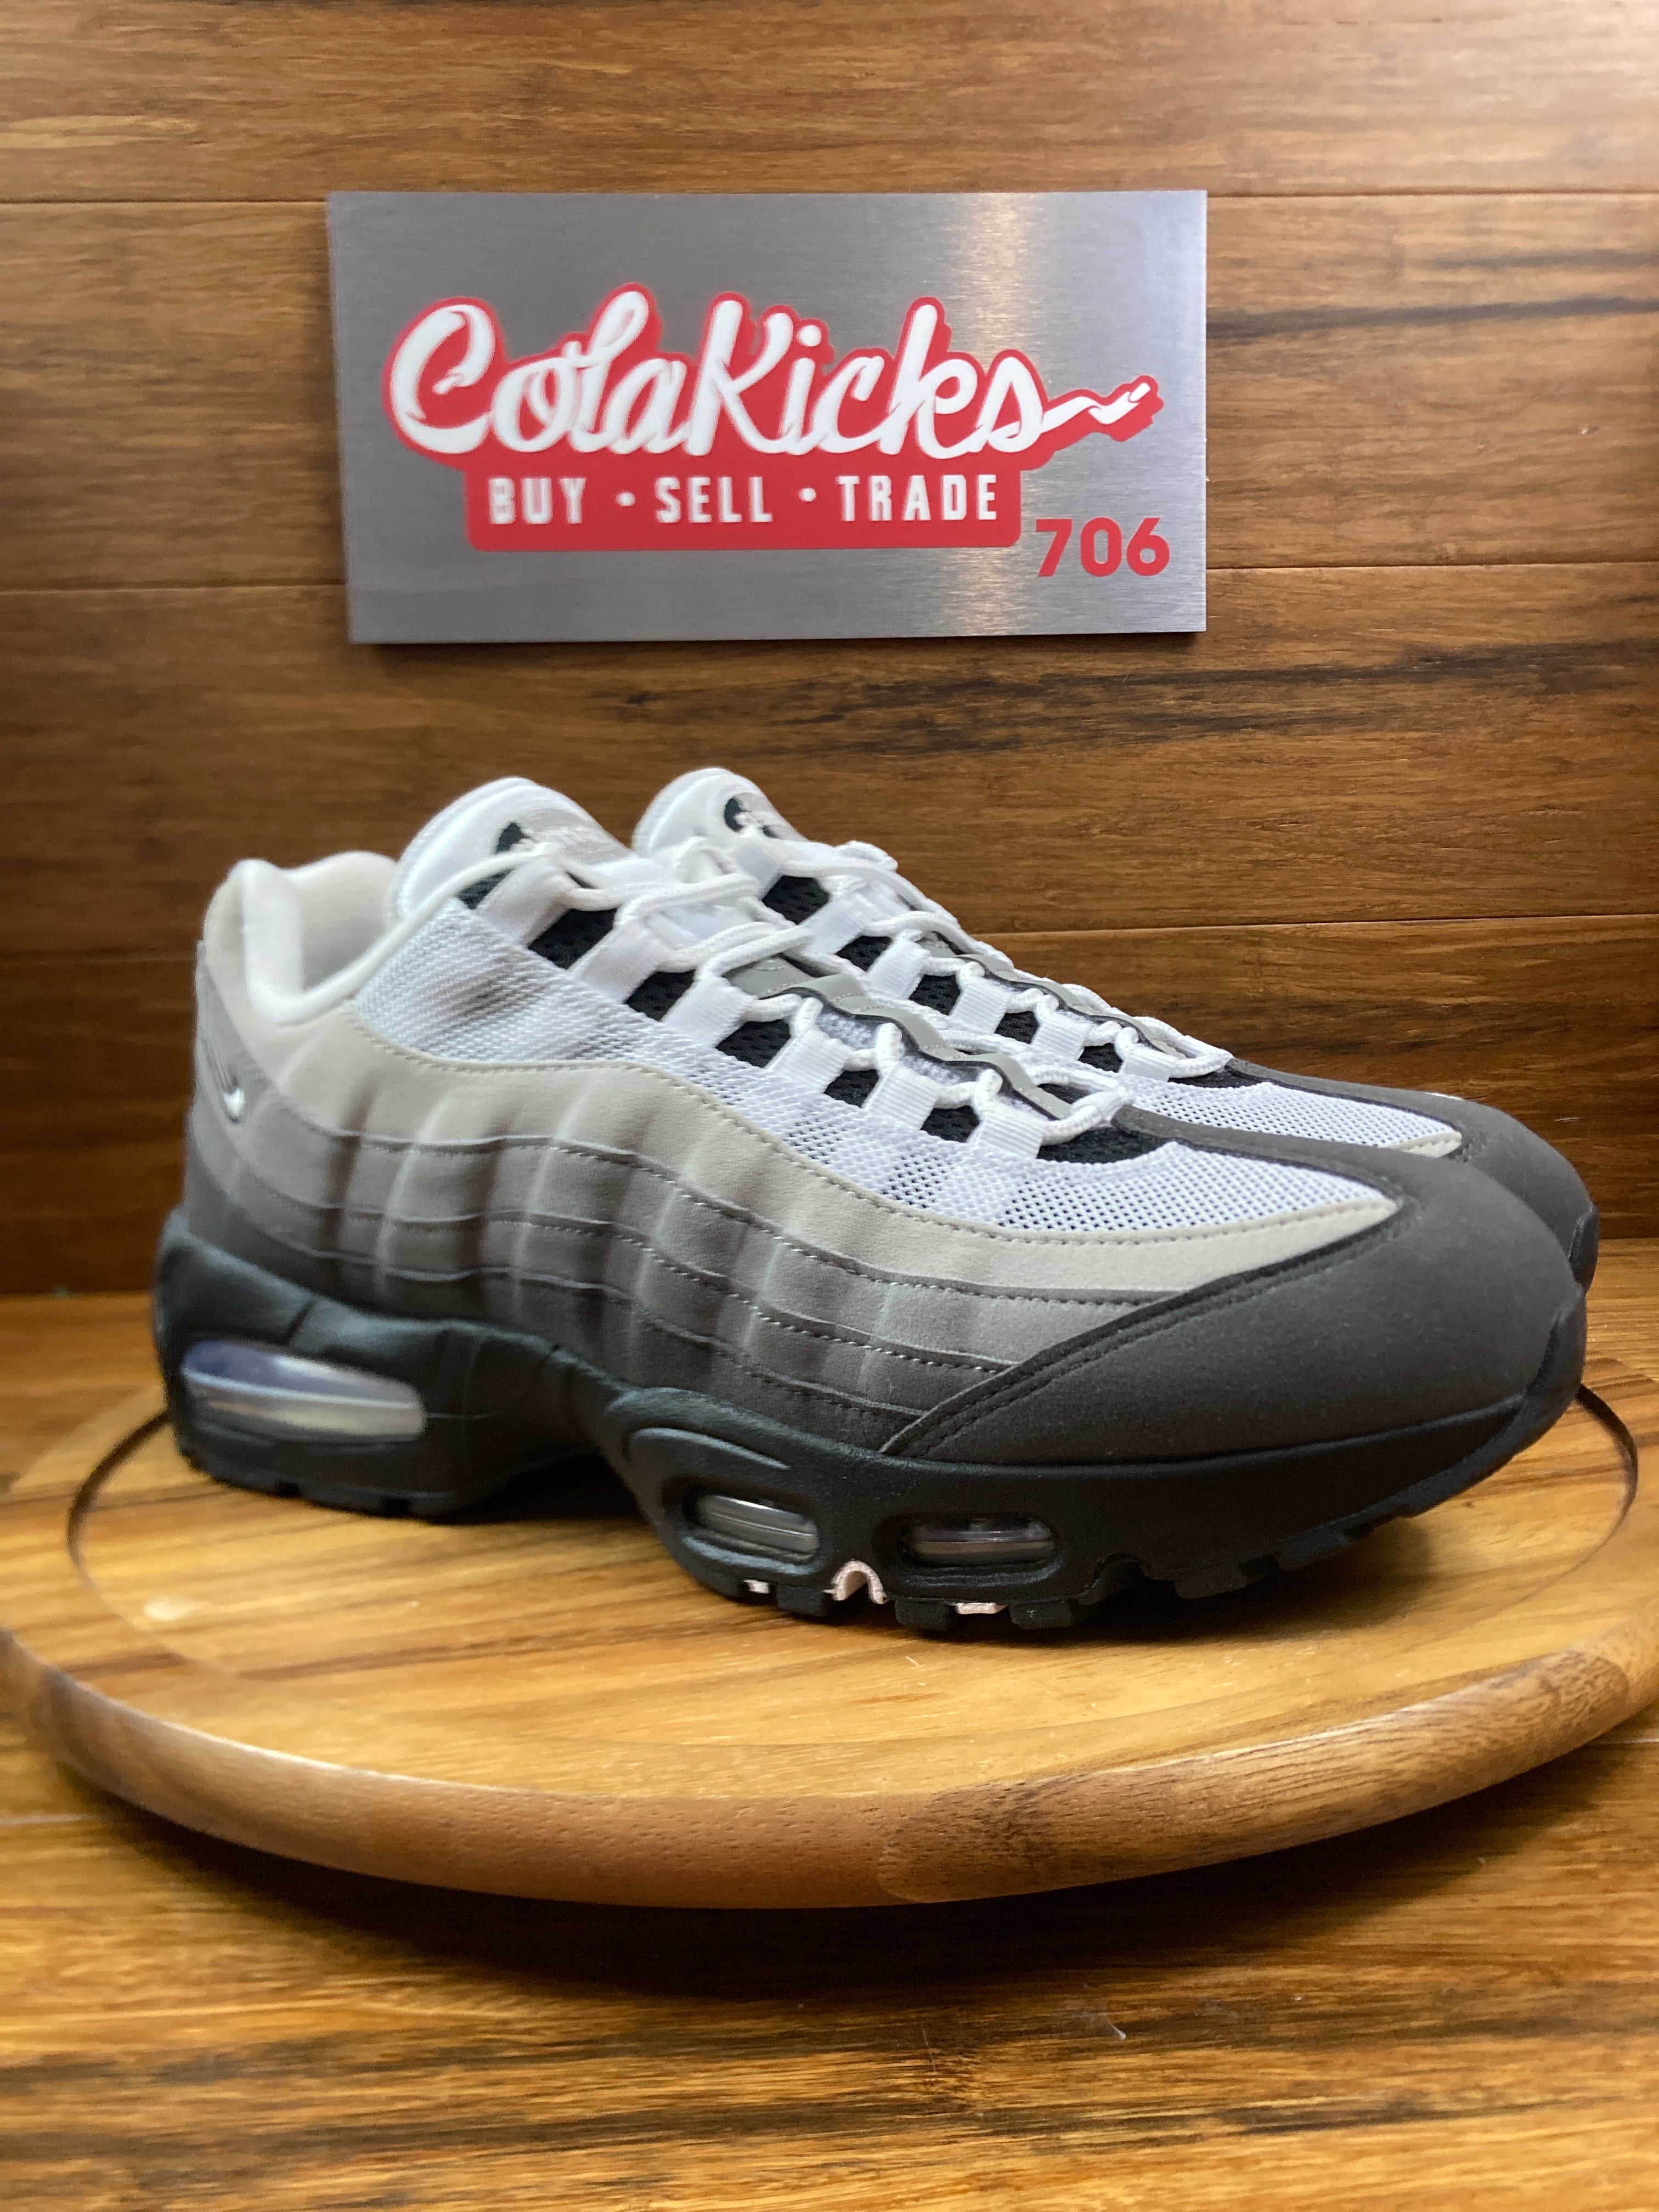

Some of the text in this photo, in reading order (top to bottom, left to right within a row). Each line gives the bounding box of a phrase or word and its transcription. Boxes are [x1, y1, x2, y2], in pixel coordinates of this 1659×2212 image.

[389, 290, 1151, 459] ColaKicks
[489, 473, 997, 524] BUY SELL TRADE
[1035, 516, 1170, 577] 706
